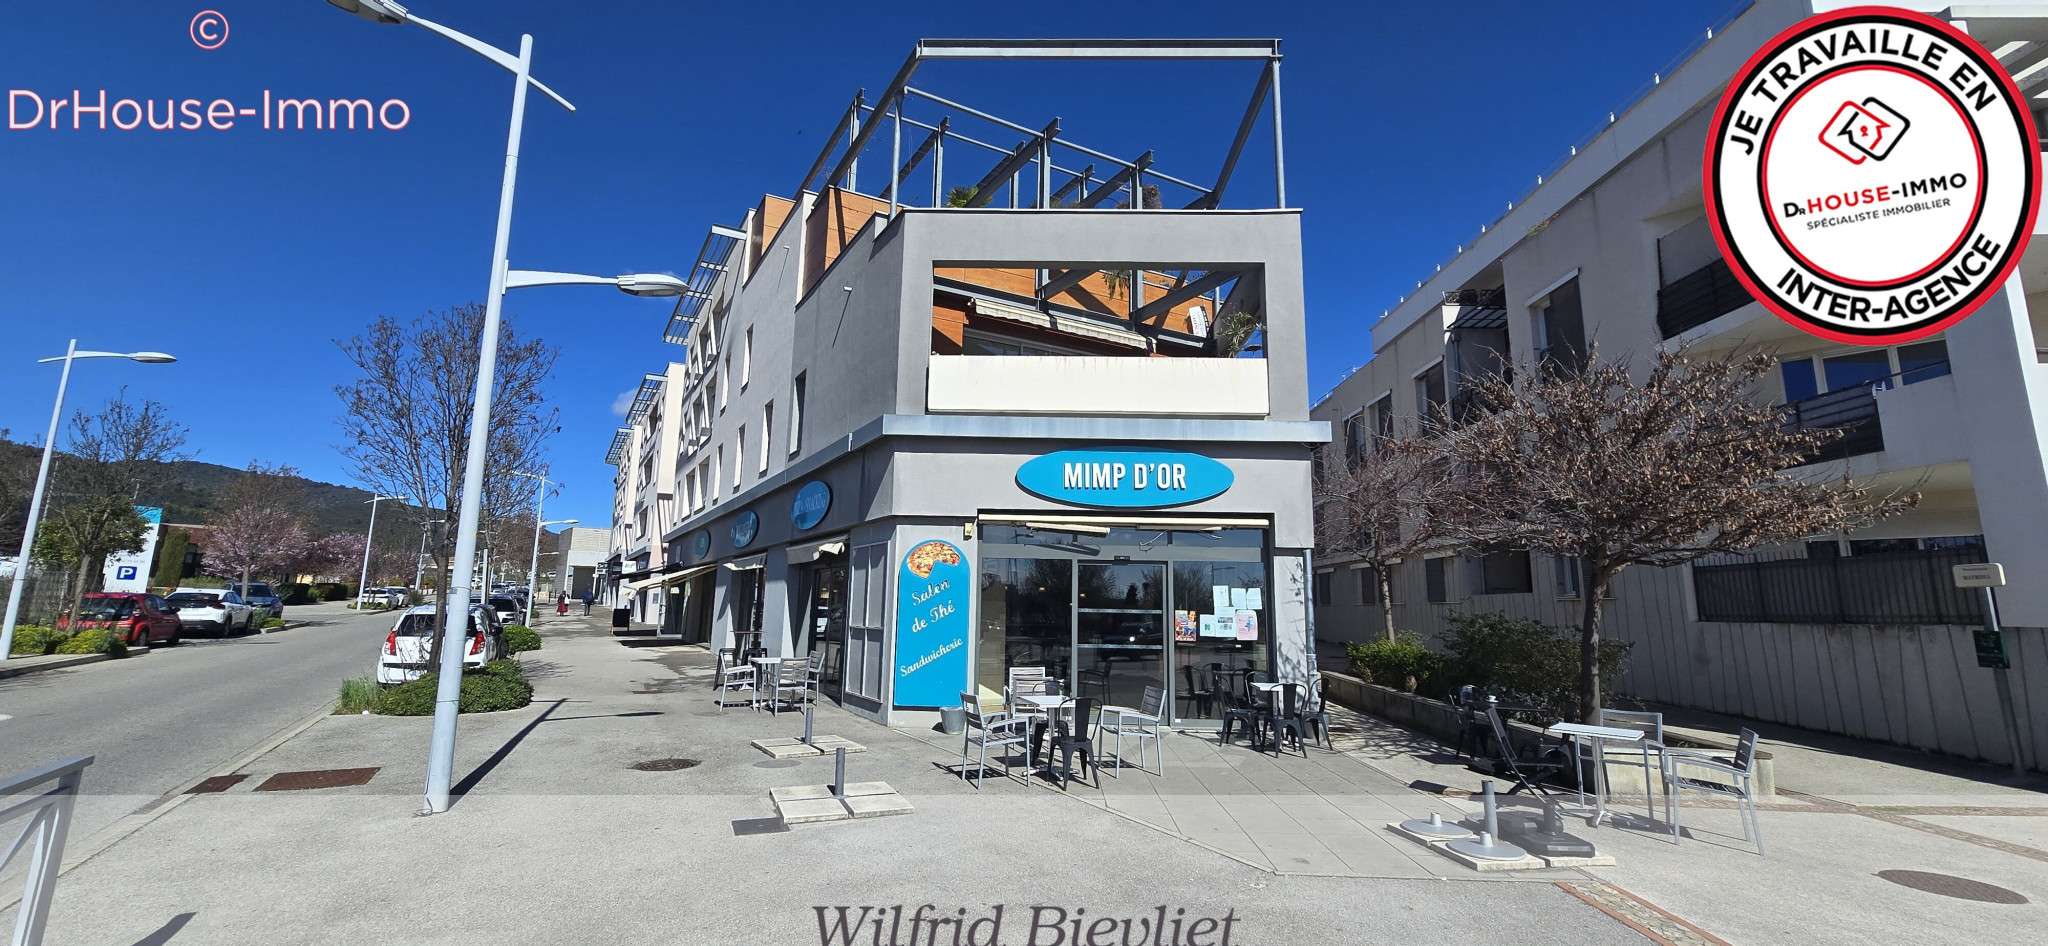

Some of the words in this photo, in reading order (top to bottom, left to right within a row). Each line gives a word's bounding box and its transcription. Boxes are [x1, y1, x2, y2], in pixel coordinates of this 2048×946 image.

[1063, 462, 1126, 490] MIMP
[1132, 463, 1187, 491] D'OR
[120, 567, 134, 579] P
[911, 579, 950, 606] Salon
[911, 617, 928, 633] de
[929, 600, 956, 623] Thé
[900, 638, 964, 677] Sandwicherie
